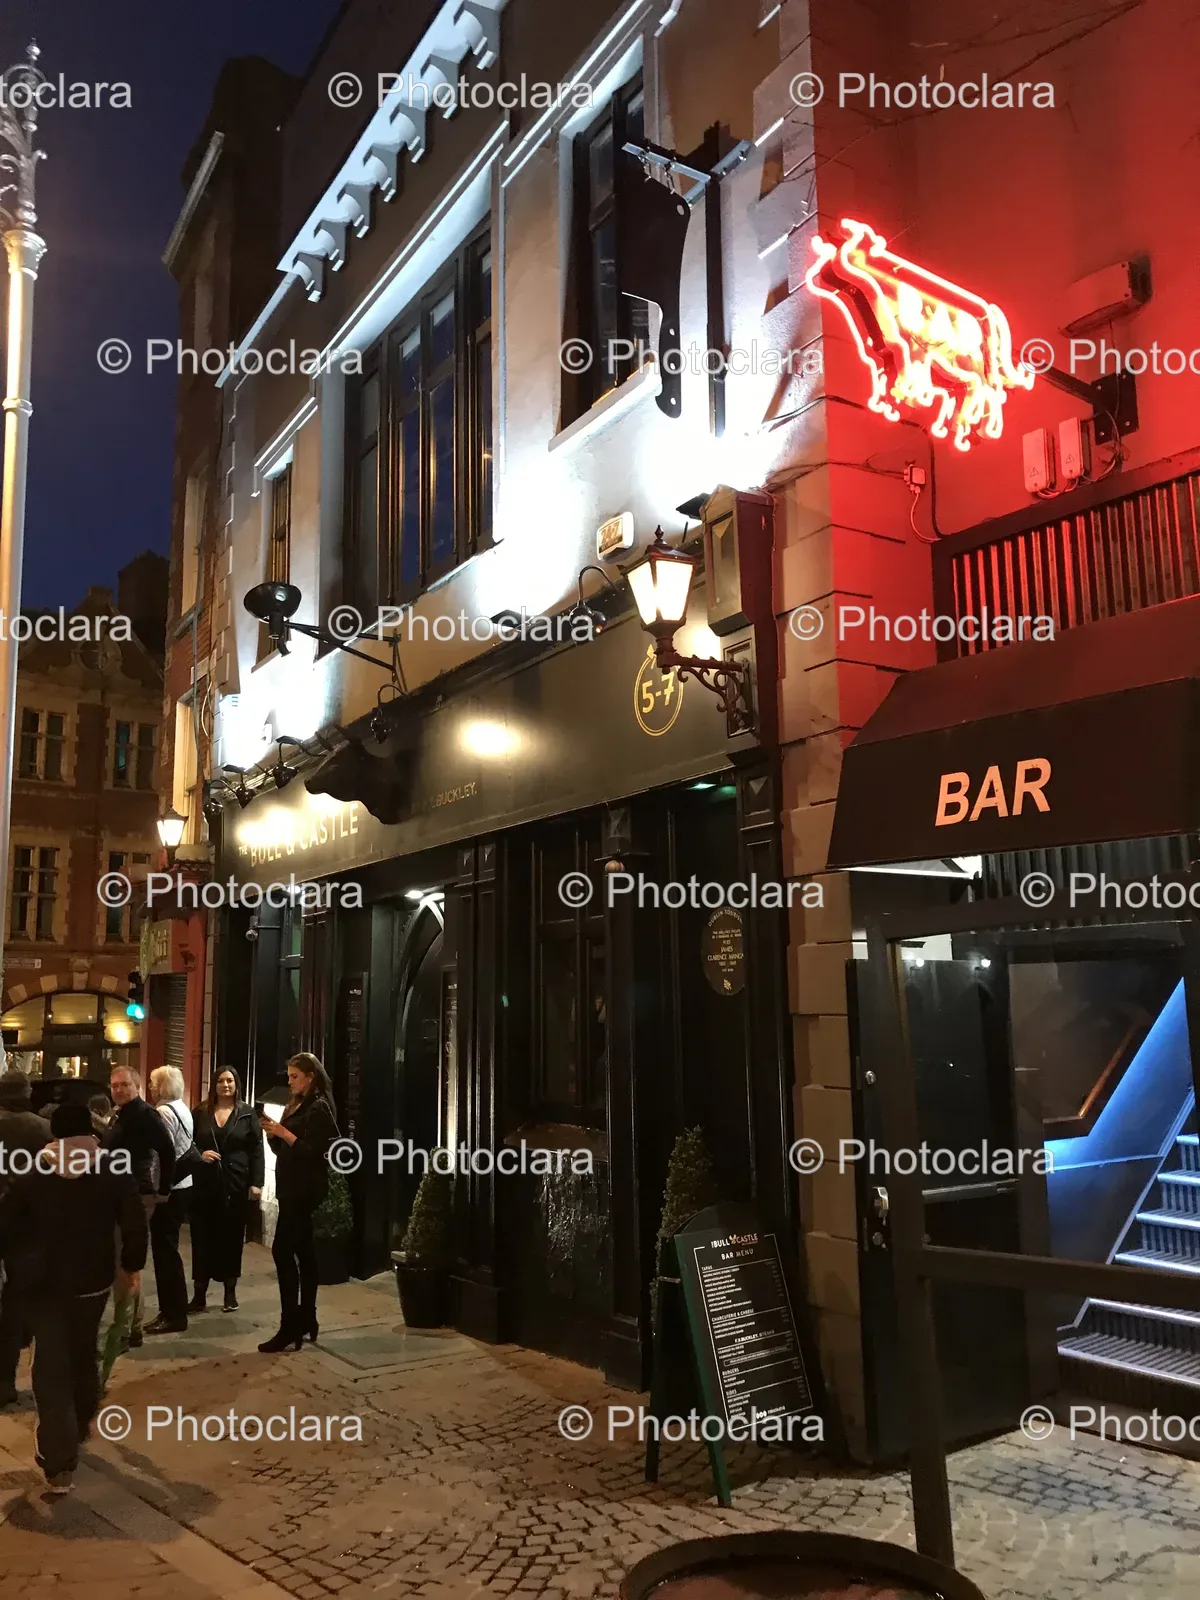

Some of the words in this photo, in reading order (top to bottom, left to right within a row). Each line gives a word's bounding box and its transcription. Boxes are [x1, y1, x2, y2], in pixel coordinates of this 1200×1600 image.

[641, 671, 675, 713] 5-7
[935, 757, 1052, 826] BAR
[299, 803, 359, 851] CASTLE
[707, 911, 723, 927] DUBLIN
[736, 1233, 759, 1244] CASTLE
[721, 1252, 734, 1260] BAR
[736, 1248, 754, 1257] MENU
[711, 1312, 737, 1322] CHARCUTERIE
[740, 1308, 754, 1316] CHEESE
[722, 1367, 739, 1376] BURGERS
